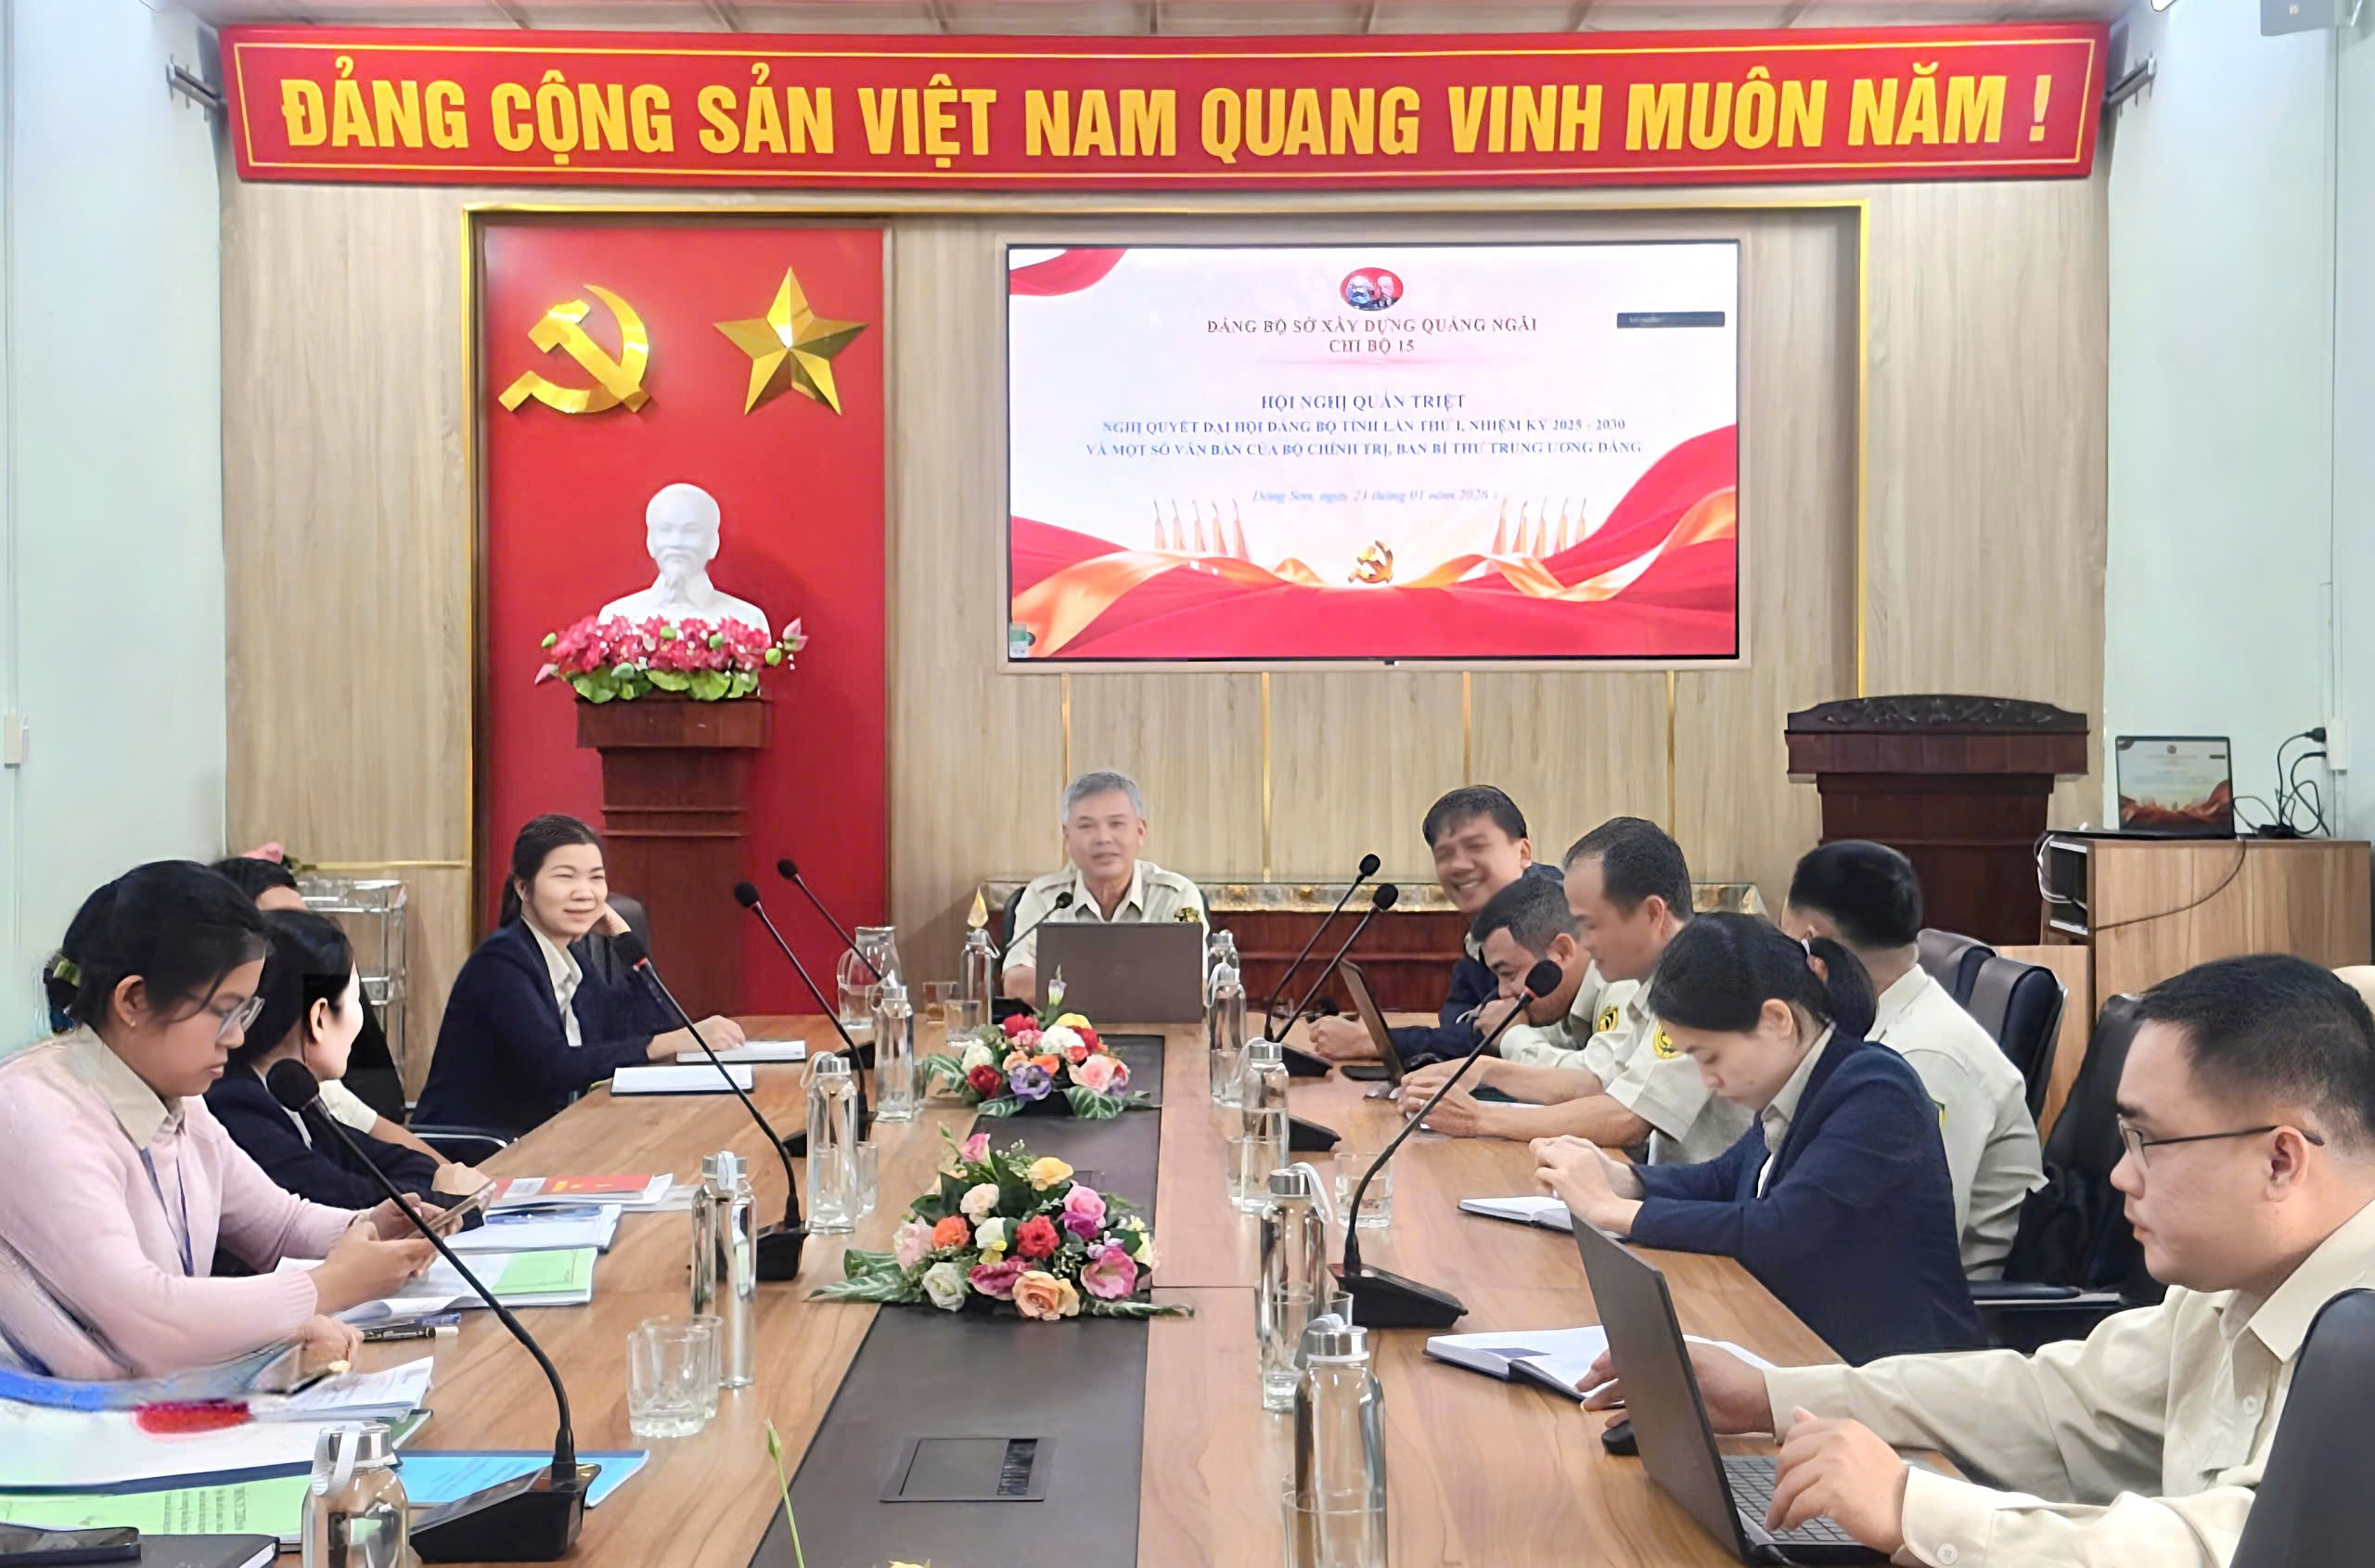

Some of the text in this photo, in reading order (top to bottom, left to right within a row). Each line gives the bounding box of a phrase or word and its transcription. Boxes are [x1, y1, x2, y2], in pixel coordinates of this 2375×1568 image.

[280, 56, 2052, 168] ĐẢNG CỘNG SẢN VIỆT NAM QUANG VINH MUÔN NĂM !
[1264, 318, 1288, 335] BỘ
[1292, 315, 1317, 333] SỞ
[1365, 317, 1416, 335] DỰNG
[1421, 315, 1485, 335] QUẢNG
[1329, 337, 1415, 354] CHI BỘ 15
[1261, 393, 1295, 412] HỘI
[1301, 394, 1346, 412] NGHỊ
[1410, 392, 1466, 412] TRIỆT
[1235, 420, 1263, 435] HỘI
[1316, 420, 1337, 435] BỘ
[1553, 418, 1582, 431] 2025
[1597, 418, 1625, 431] 2030
[1491, 442, 1543, 455] TRUNG
